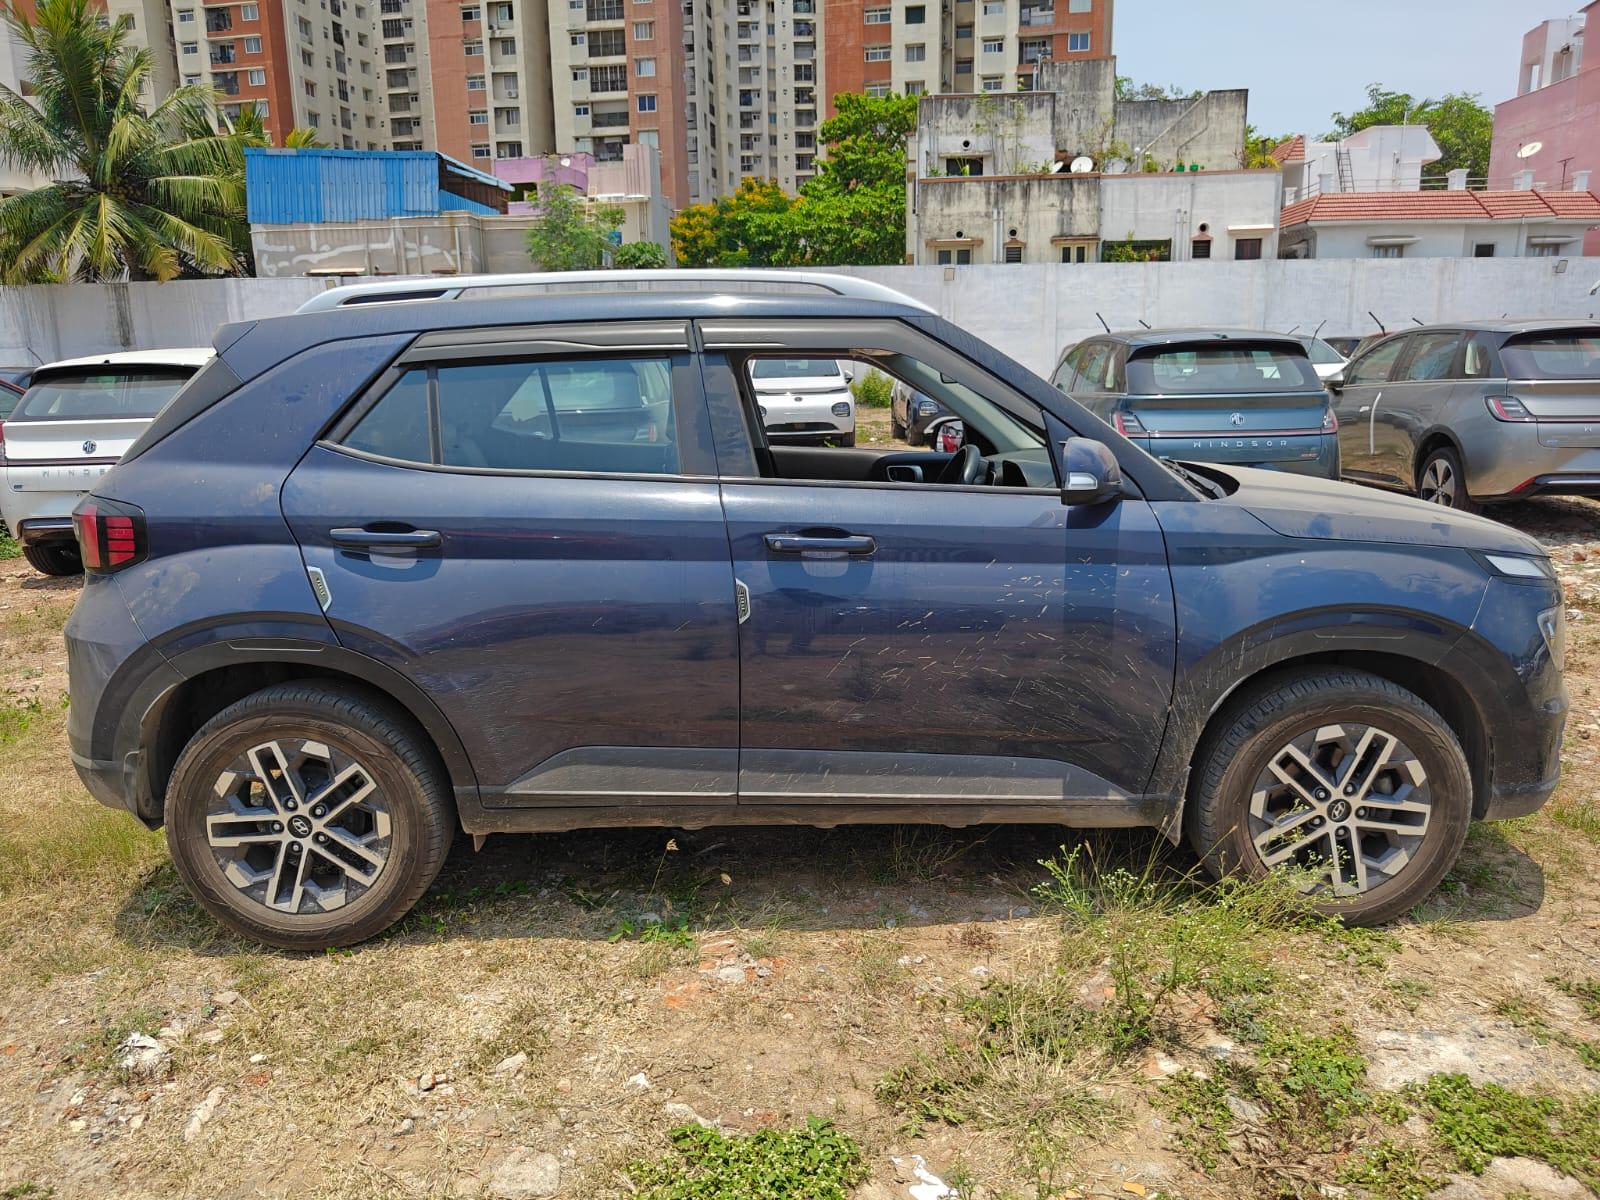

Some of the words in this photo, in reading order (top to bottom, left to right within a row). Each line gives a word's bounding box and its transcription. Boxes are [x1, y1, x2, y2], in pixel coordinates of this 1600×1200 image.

[1230, 412, 1245, 427] MG
[83, 440, 97, 454] MG
[1193, 440, 1287, 448] WINDSOR
